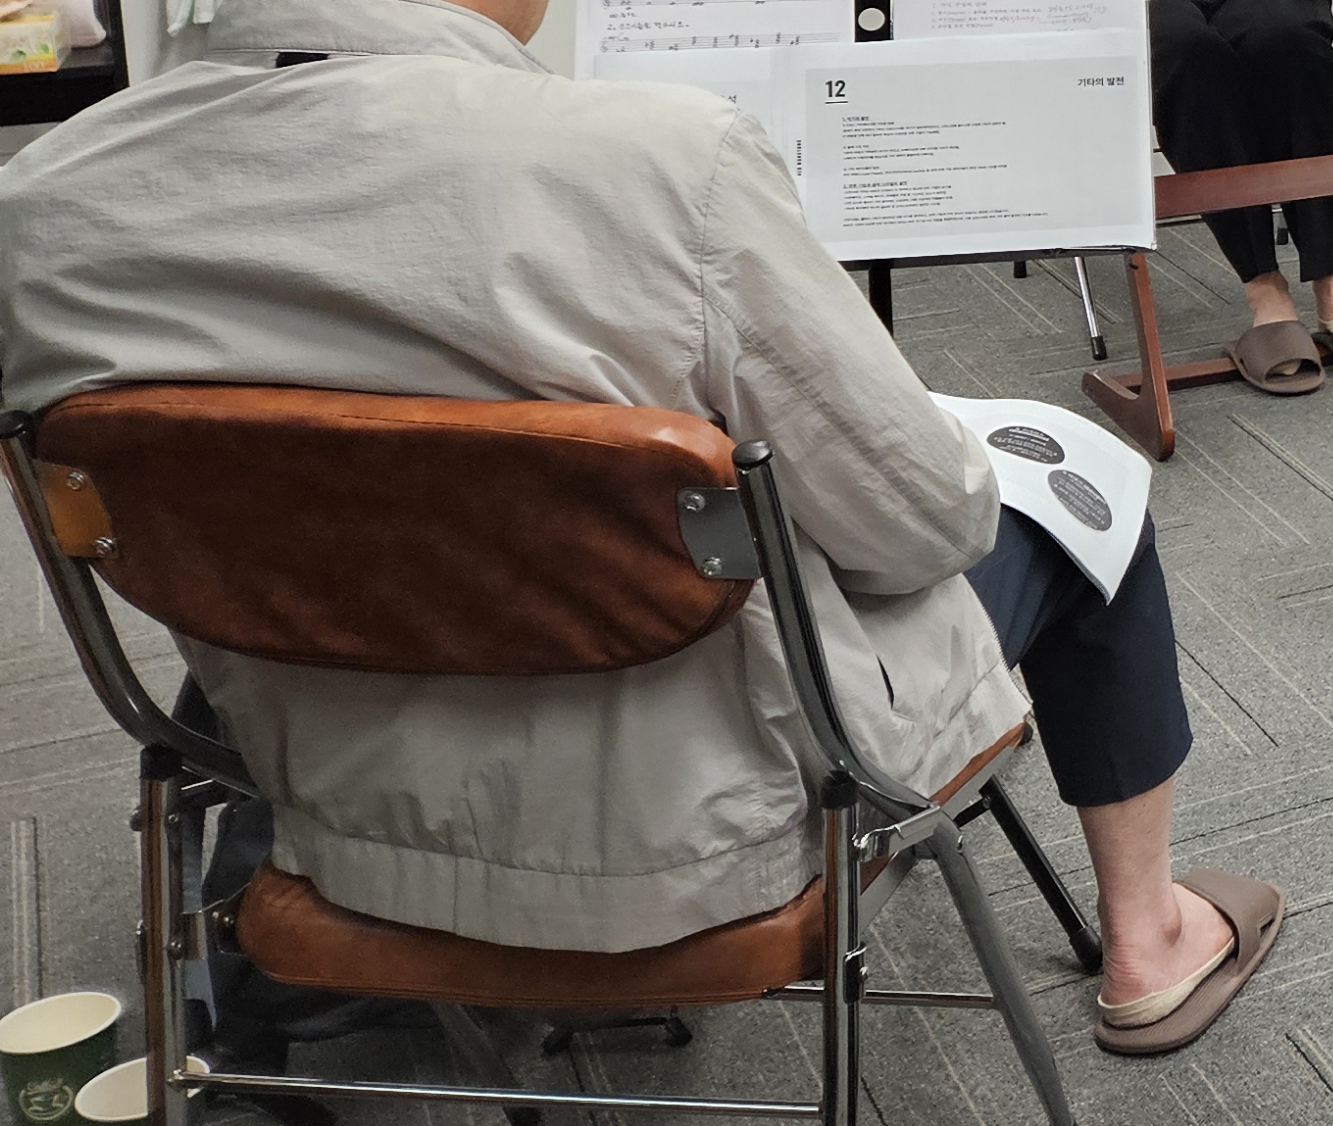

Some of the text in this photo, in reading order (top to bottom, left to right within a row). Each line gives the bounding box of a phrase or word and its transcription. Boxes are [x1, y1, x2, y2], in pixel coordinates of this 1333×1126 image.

[1077, 76, 1125, 87] 기타의 발전
[825, 80, 846, 98] 12
